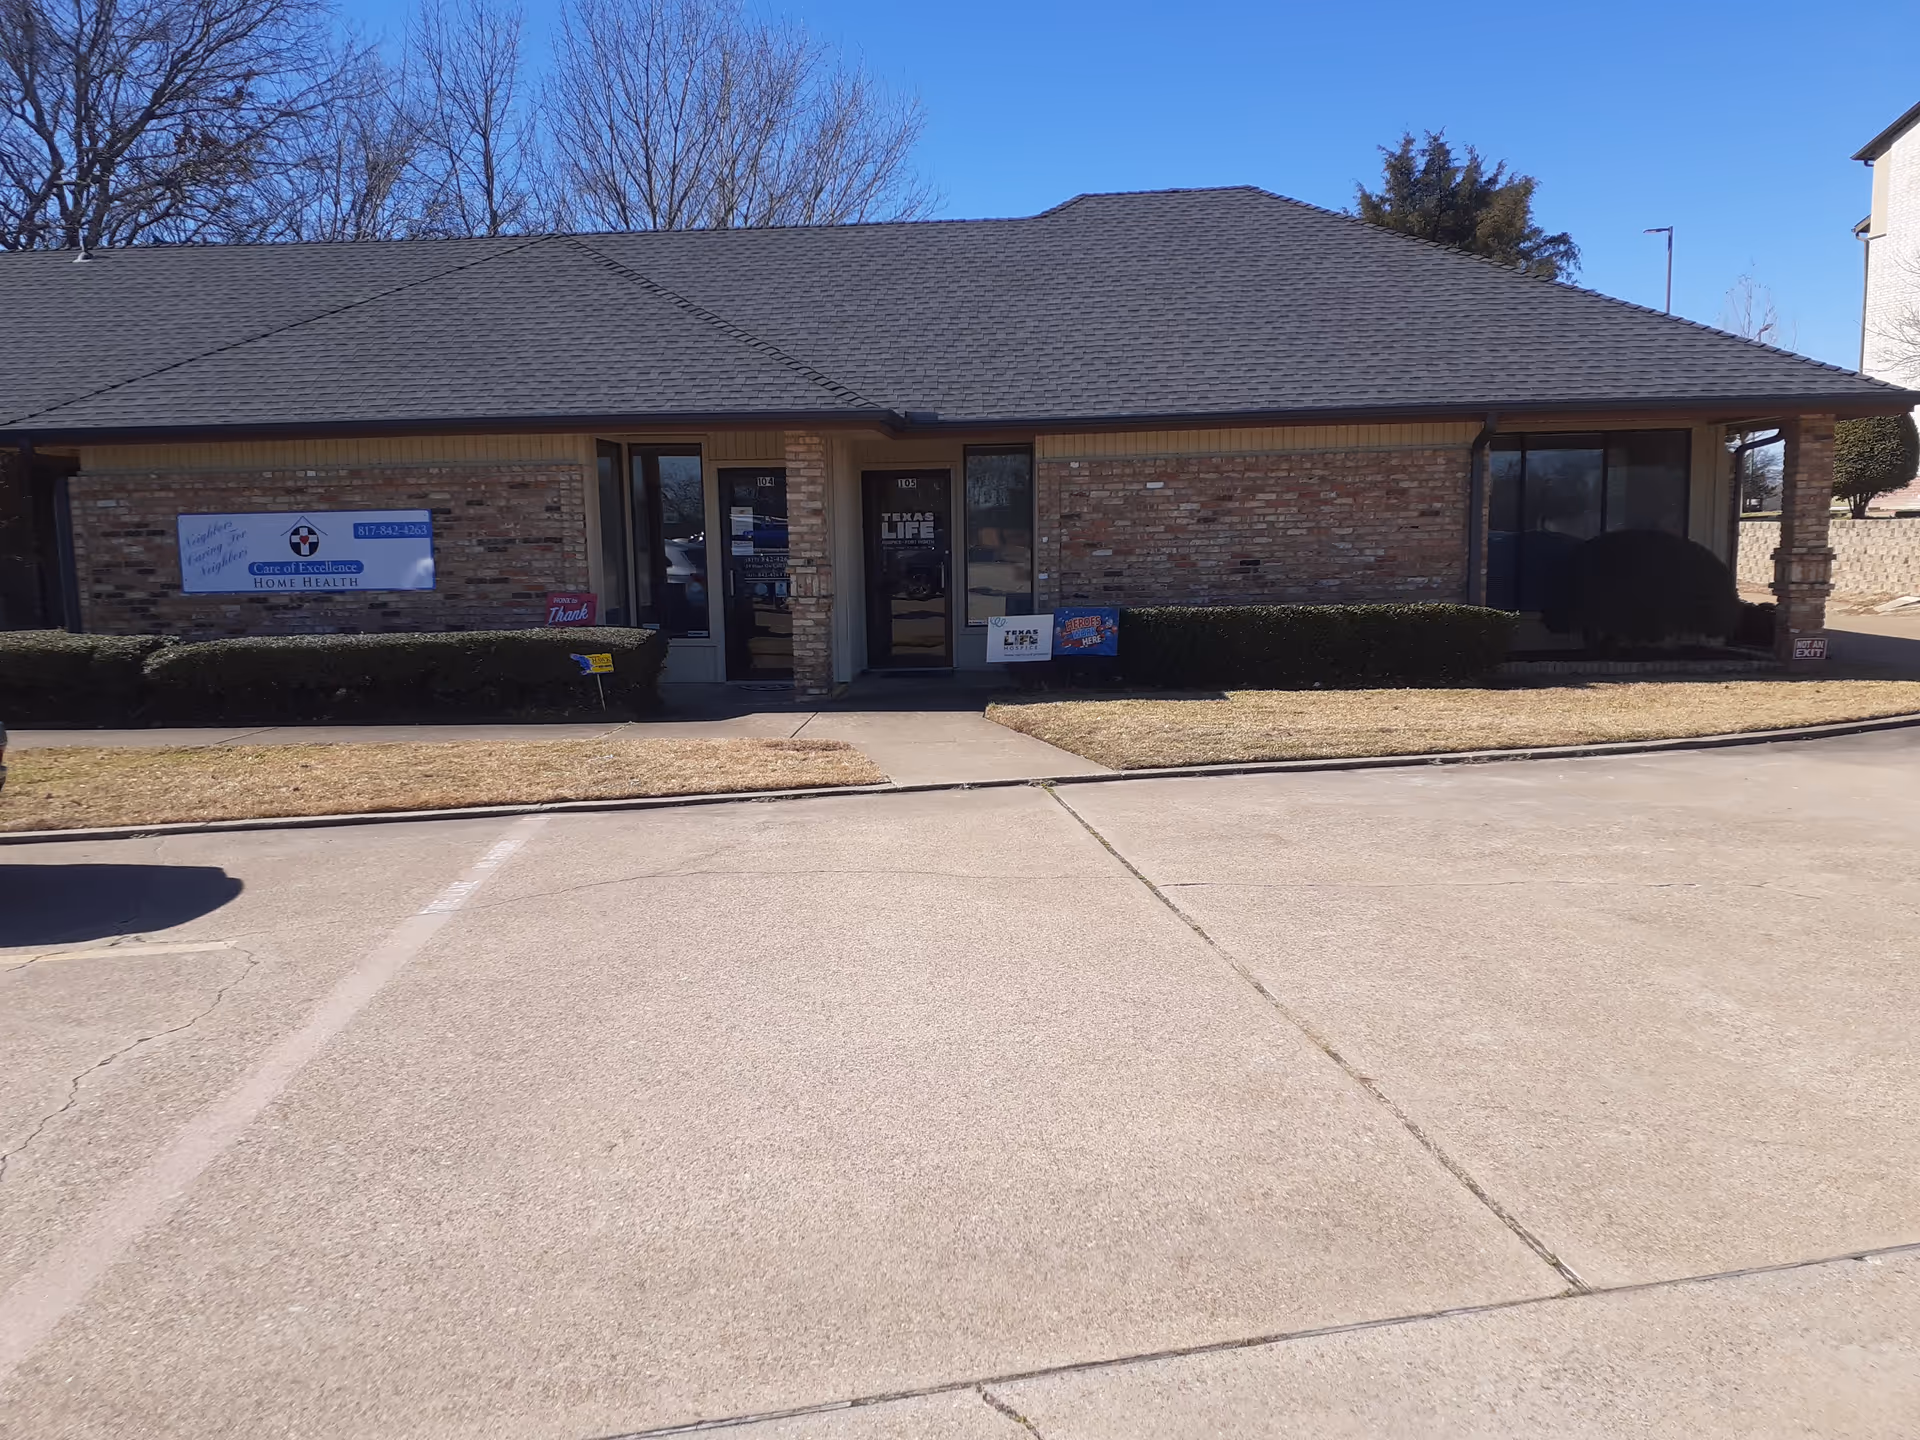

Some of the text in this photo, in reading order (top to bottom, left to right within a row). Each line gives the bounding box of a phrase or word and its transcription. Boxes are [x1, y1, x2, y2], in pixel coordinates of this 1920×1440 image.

[758, 477, 773, 486] 104
[897, 479, 916, 488] 105
[881, 512, 934, 522] TEXAS
[357, 524, 428, 536] 817-842-4263
[881, 521, 935, 539] LIFE
[253, 560, 358, 574] Care of Excellence
[253, 577, 358, 589] HOME HEALTH
[548, 603, 589, 624] Thank
[1065, 616, 1102, 632] HEROES
[1071, 627, 1097, 640] WORK
[1003, 635, 1038, 646] LIFE
[1082, 634, 1102, 646] HERE
[1796, 640, 1825, 648] NOT AN
[1795, 649, 1823, 657] EXIT
